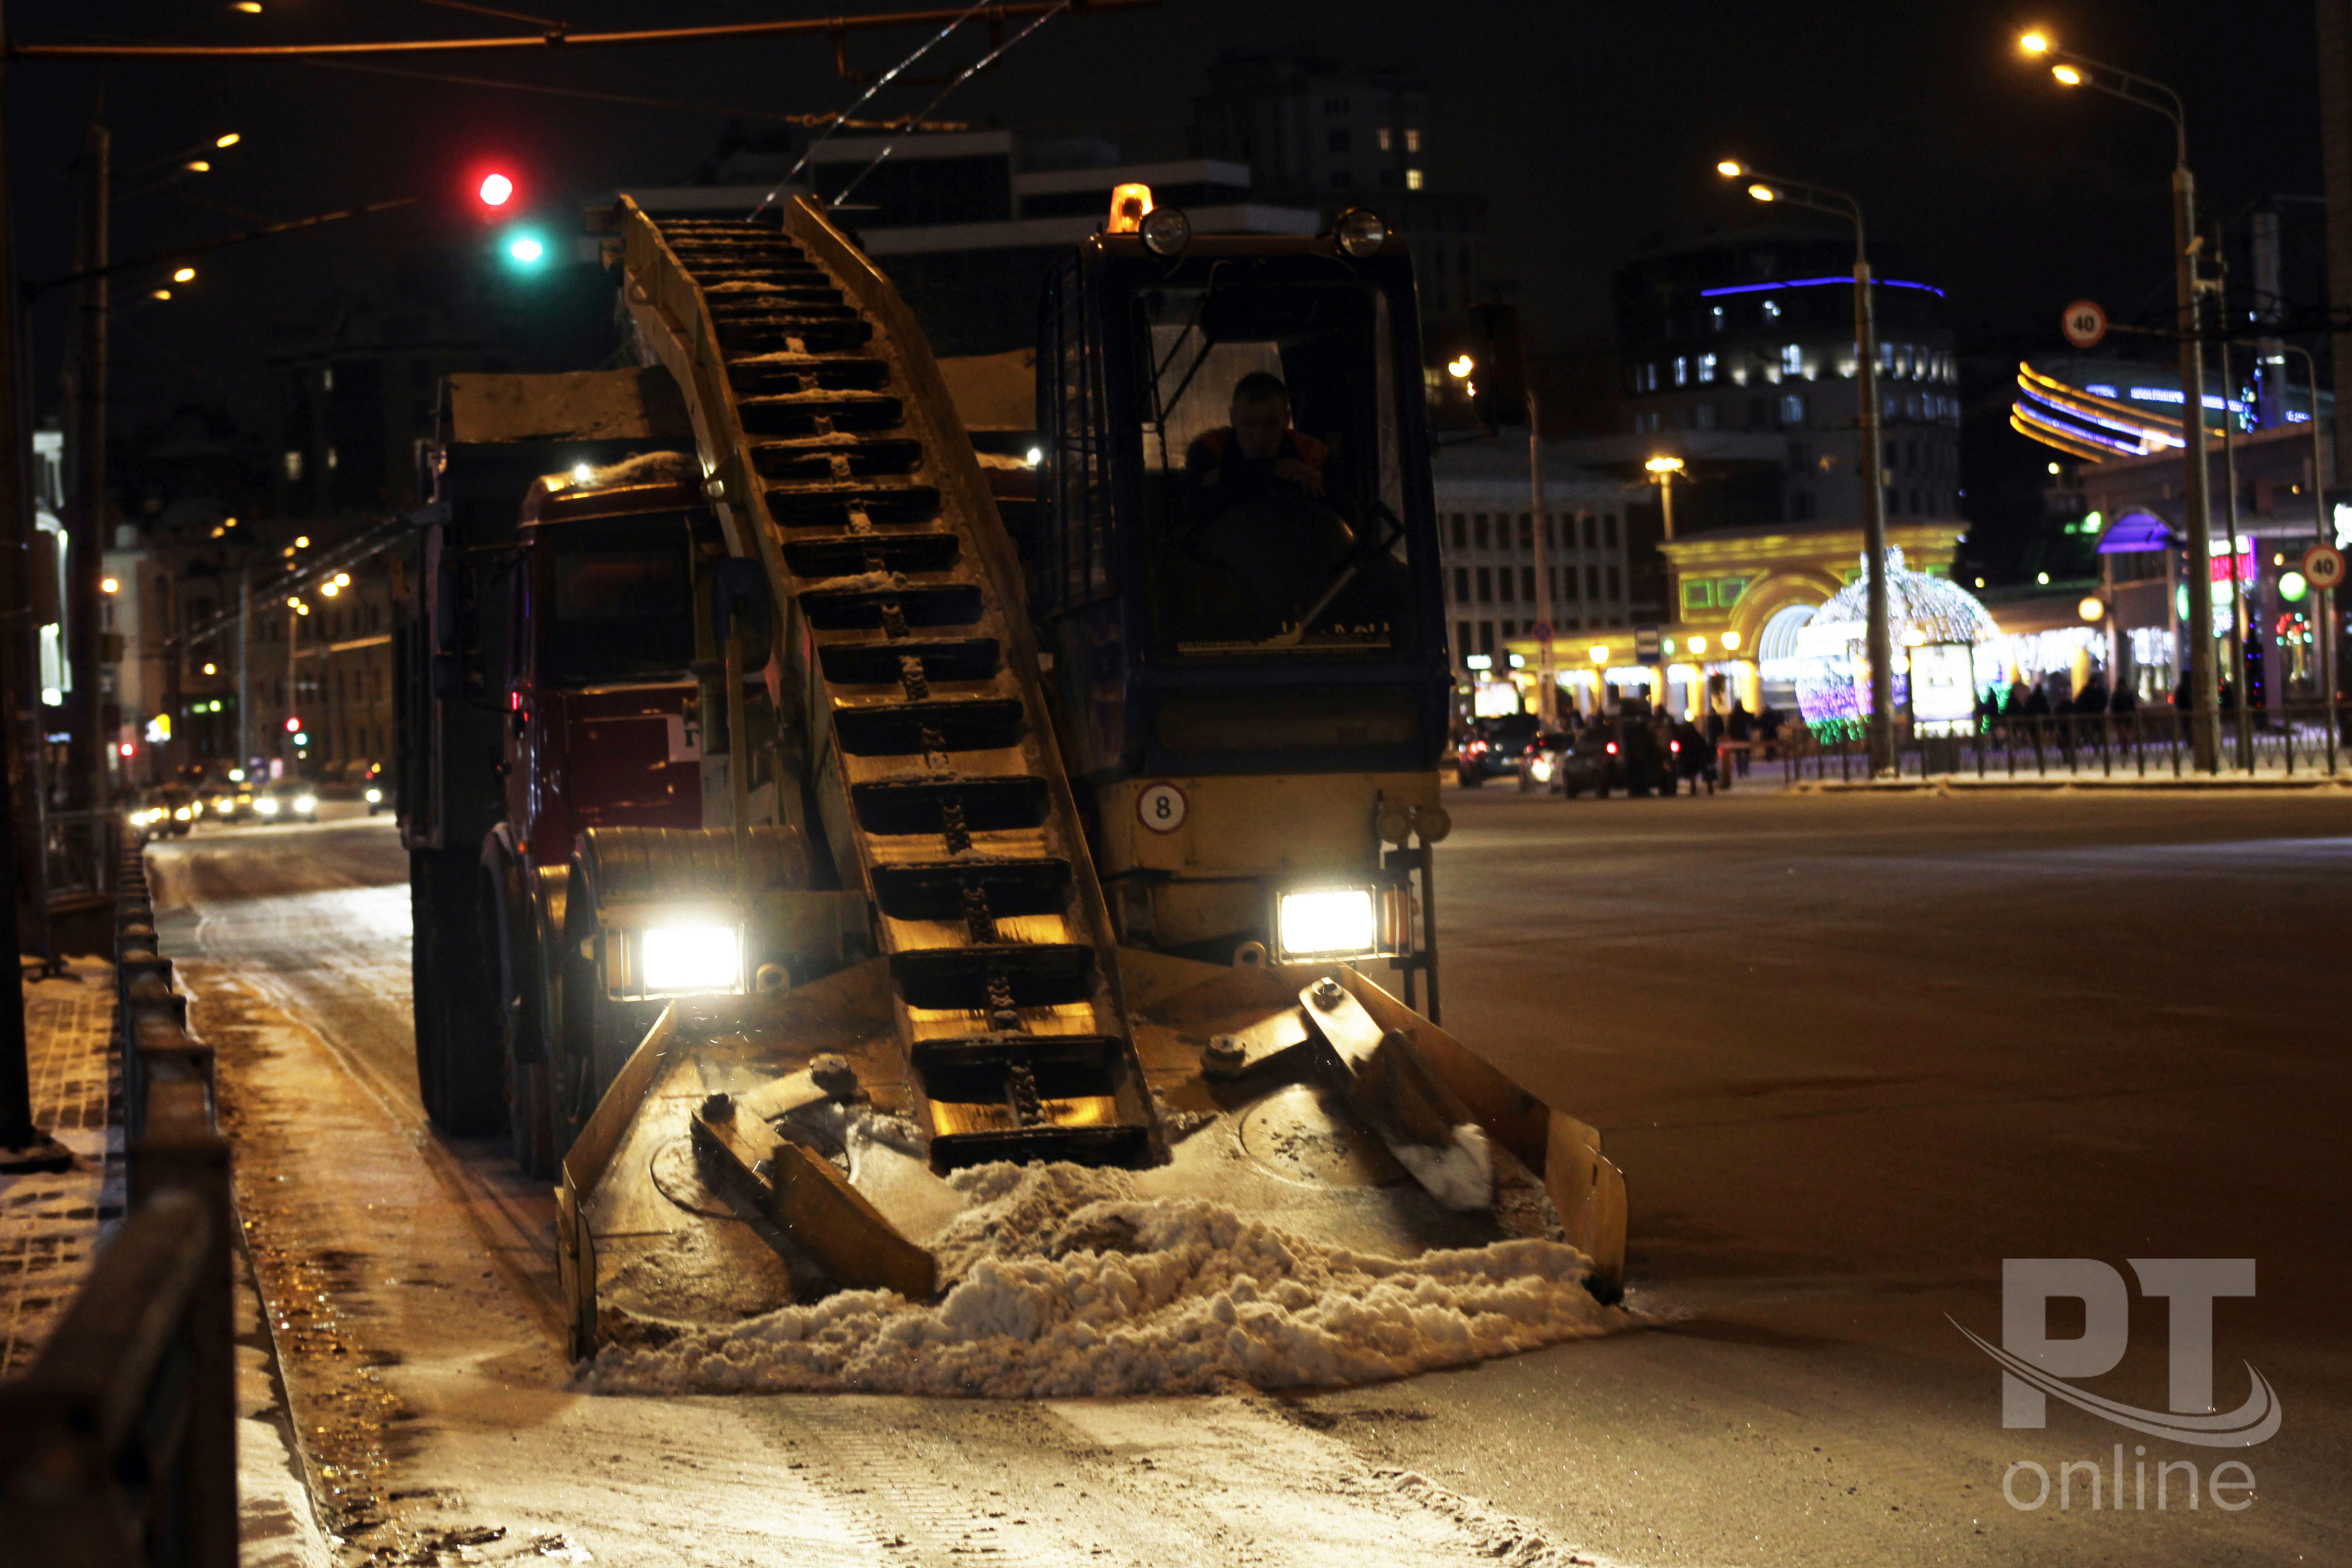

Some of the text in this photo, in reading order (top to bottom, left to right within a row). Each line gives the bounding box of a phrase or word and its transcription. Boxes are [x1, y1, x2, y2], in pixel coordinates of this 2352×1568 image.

[2073, 315, 2095, 332] 40
[2313, 559, 2334, 576] 40
[1156, 796, 1171, 819] 8
